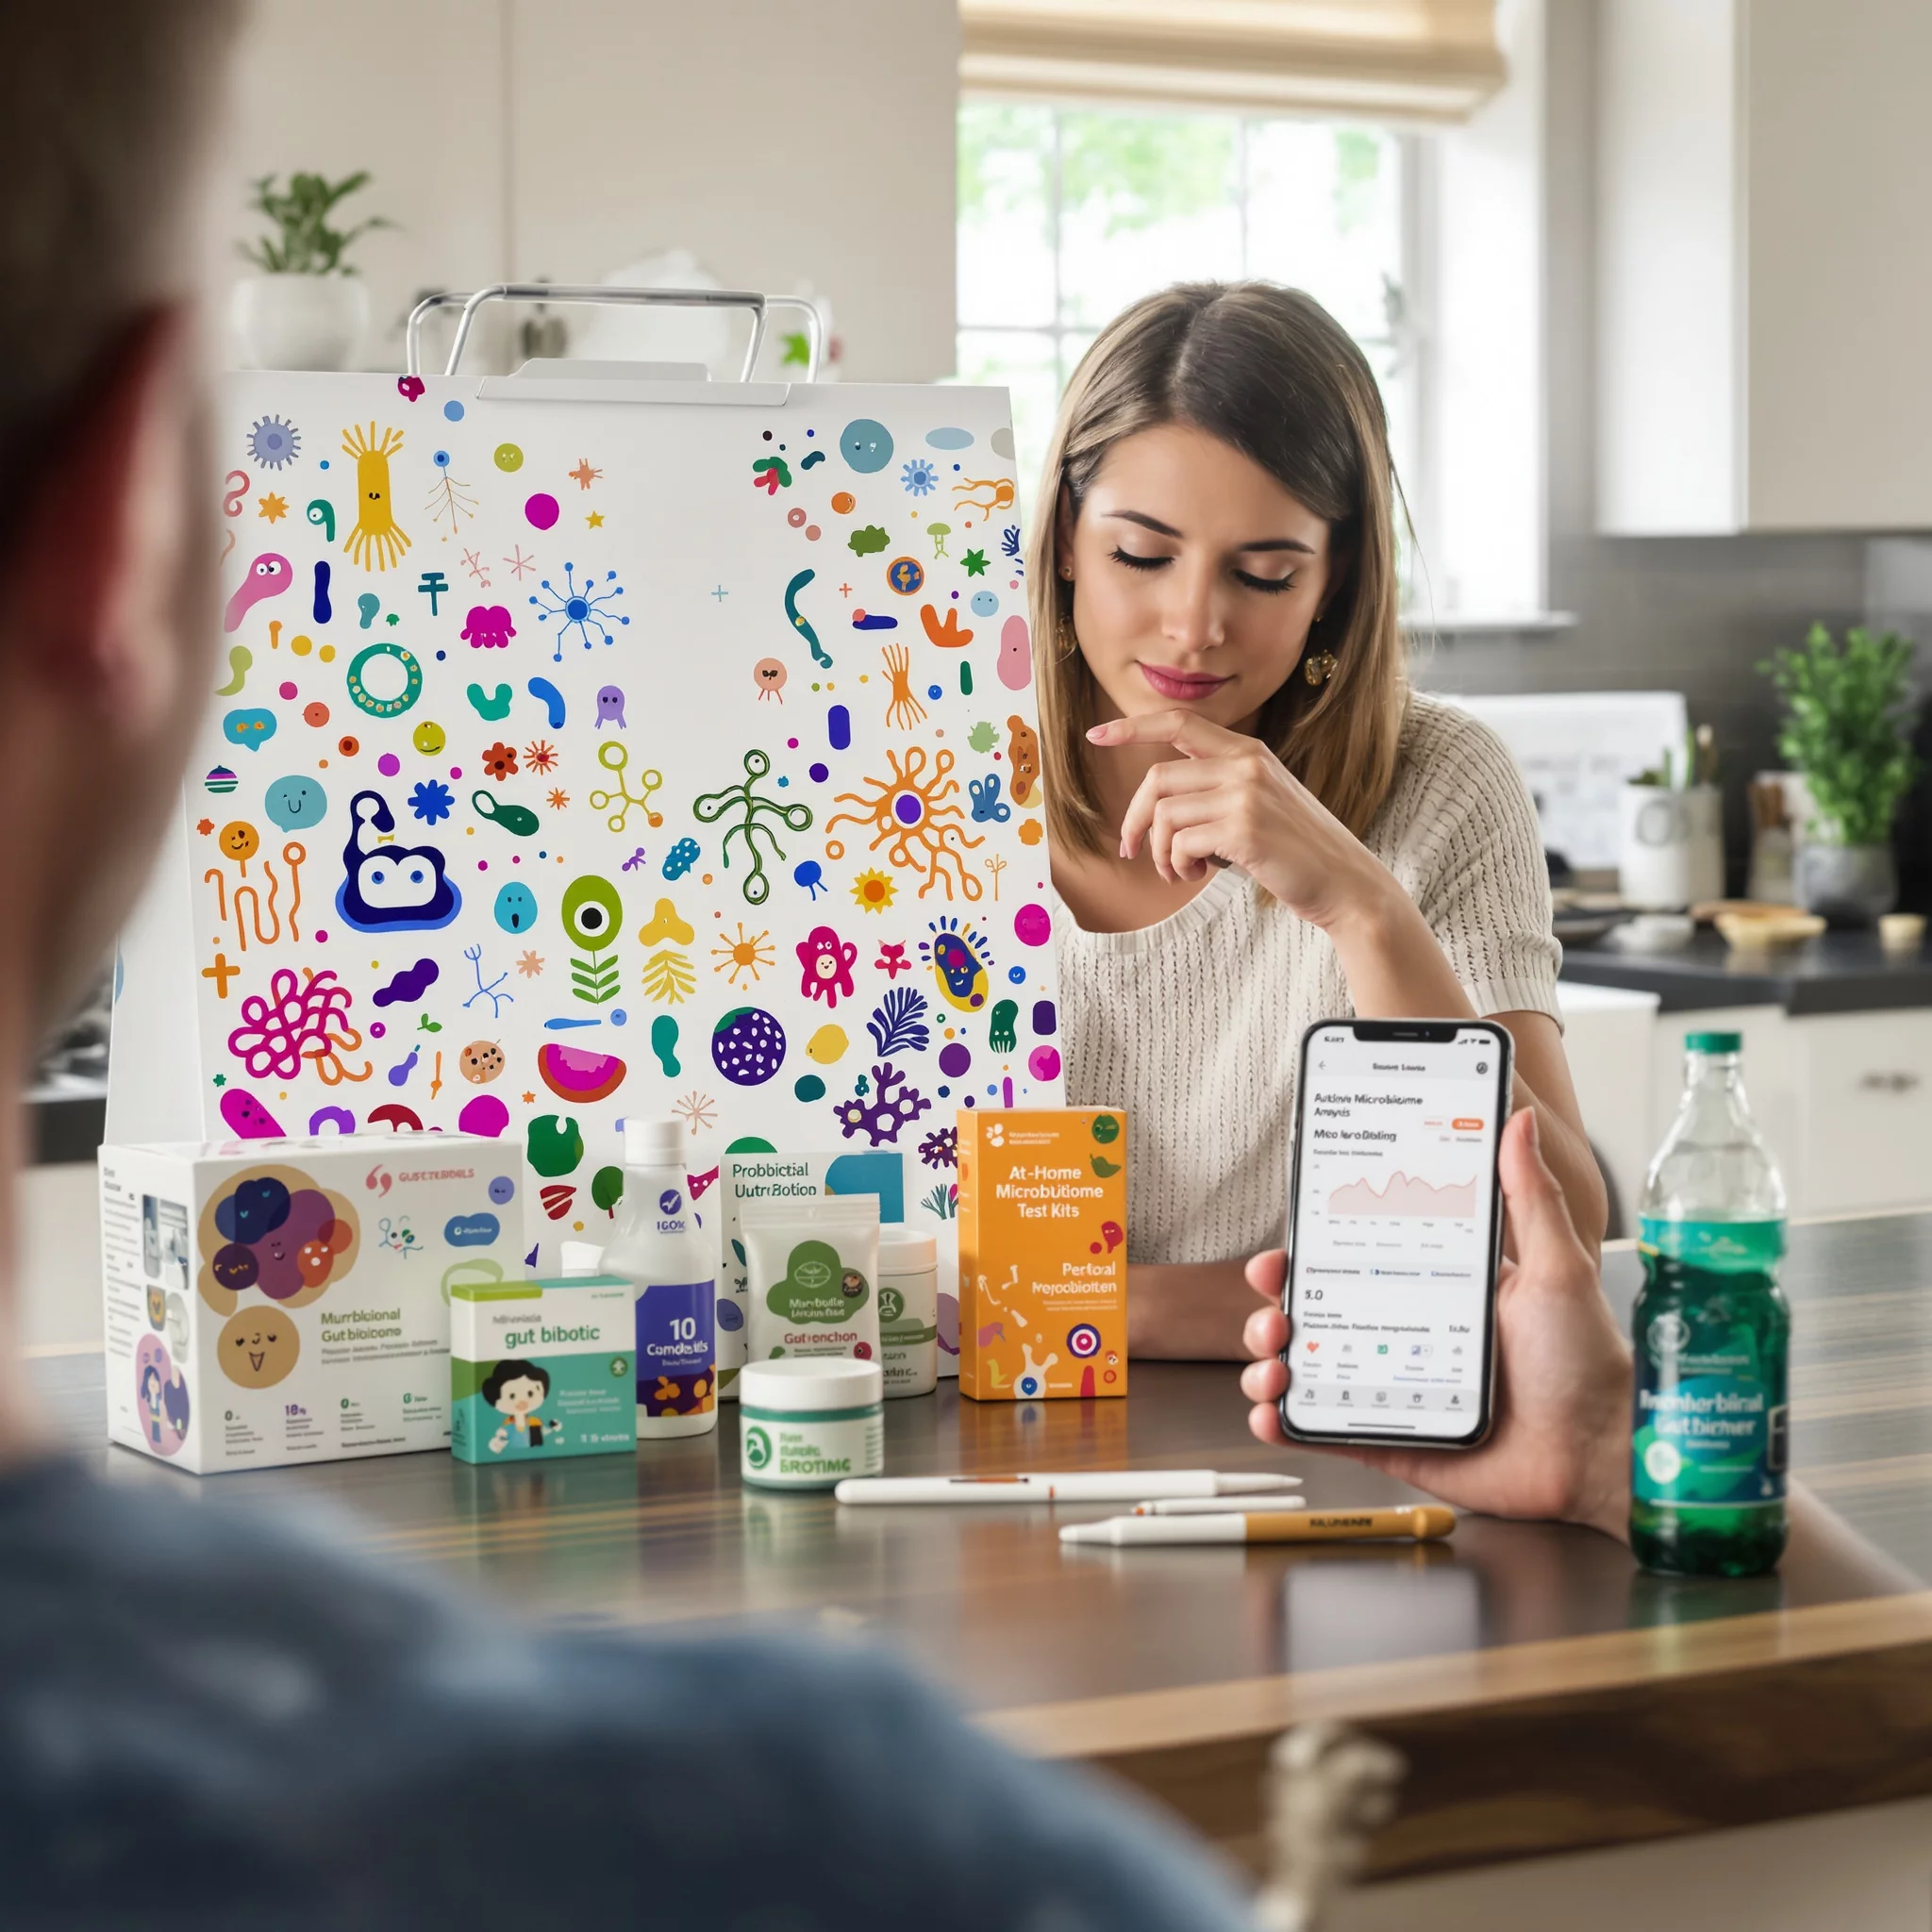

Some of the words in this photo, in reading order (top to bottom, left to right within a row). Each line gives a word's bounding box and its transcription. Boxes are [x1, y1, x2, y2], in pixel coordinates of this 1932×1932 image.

[1009, 1166, 1082, 1180] At-Home
[1018, 1203, 1047, 1218] Test
[505, 1328, 536, 1350] gut
[541, 1324, 601, 1343] bibotic
[669, 1317, 696, 1341] 10
